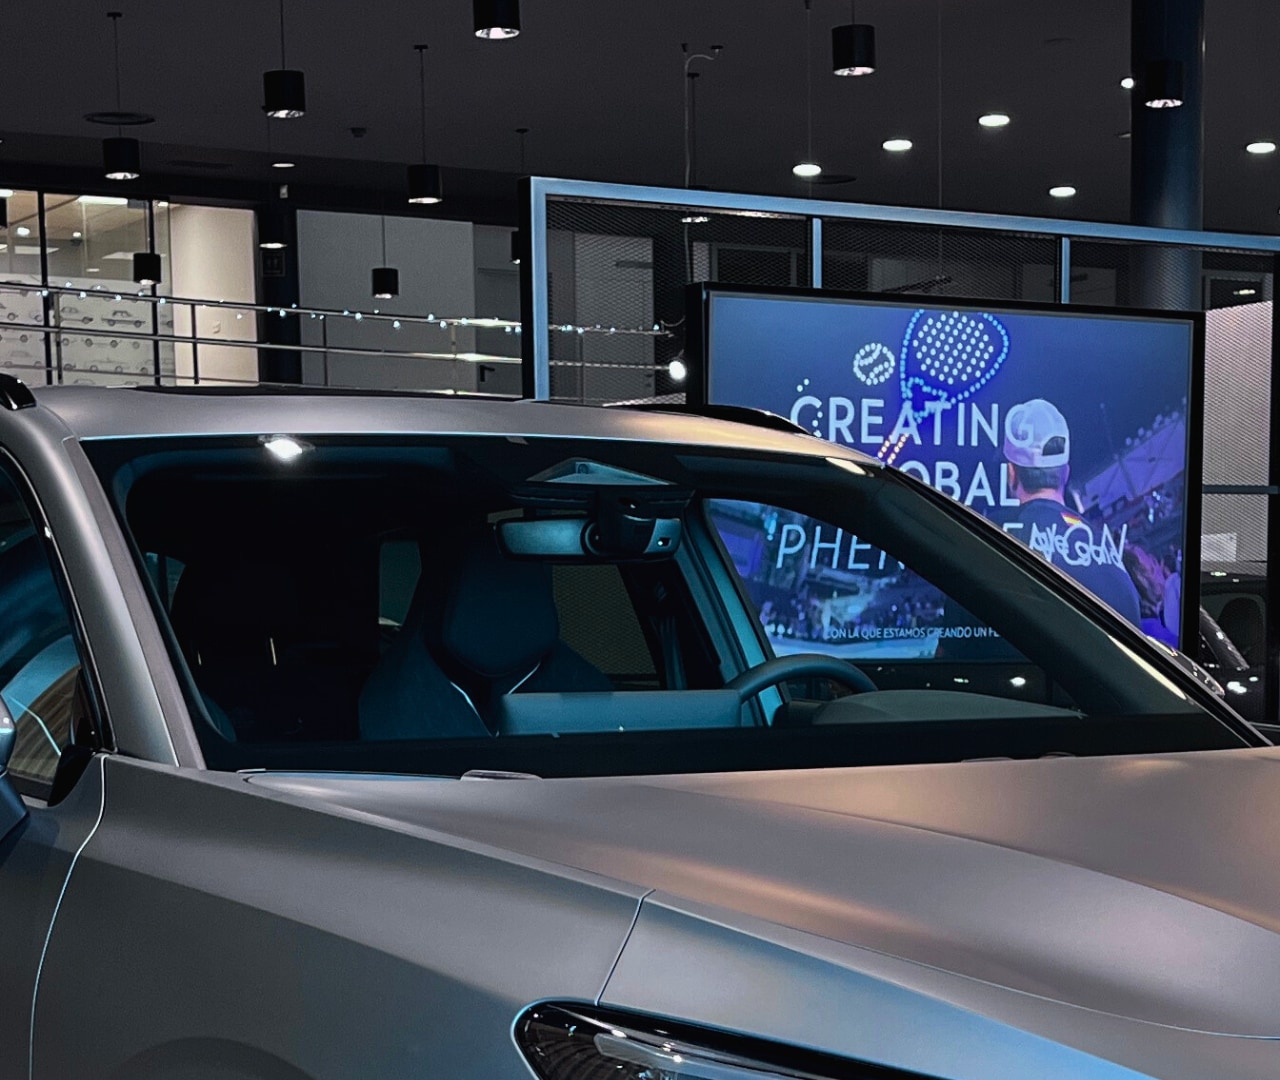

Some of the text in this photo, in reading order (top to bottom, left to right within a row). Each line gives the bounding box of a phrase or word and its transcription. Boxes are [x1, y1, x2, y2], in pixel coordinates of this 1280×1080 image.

[790, 395, 1035, 449] CREATING
[847, 628, 860, 639] LA
[861, 627, 882, 640] QUE
[883, 627, 926, 639] ESTAMOS
[927, 626, 972, 639] CREANDO
[973, 626, 988, 638] UN
